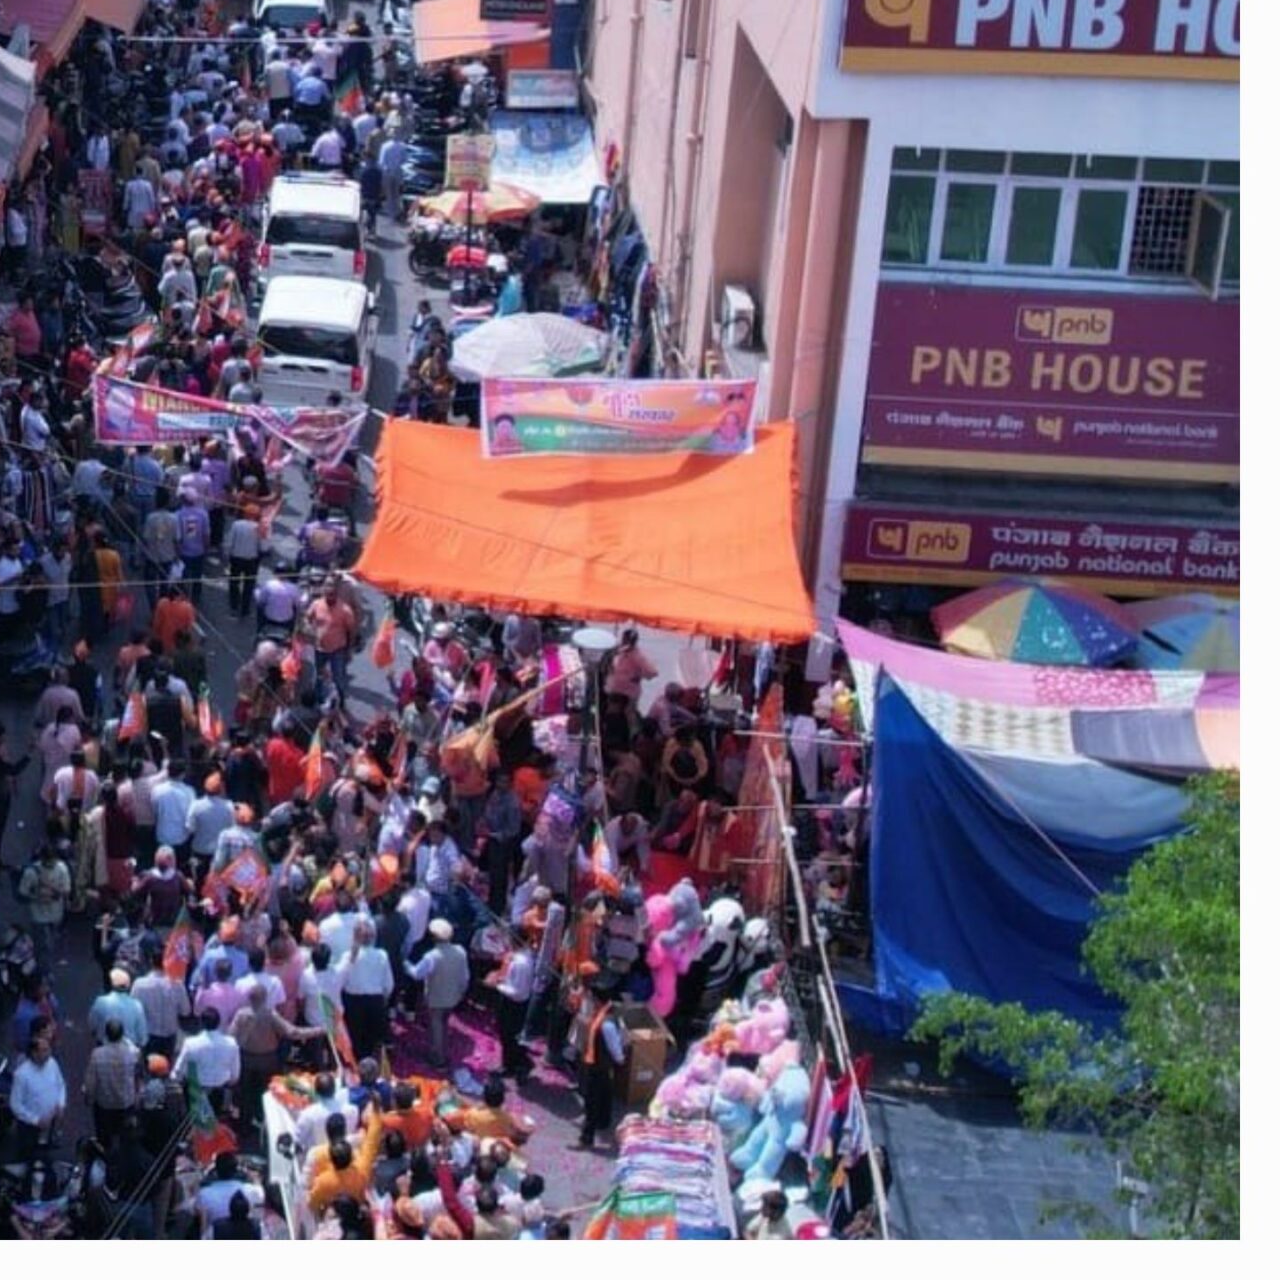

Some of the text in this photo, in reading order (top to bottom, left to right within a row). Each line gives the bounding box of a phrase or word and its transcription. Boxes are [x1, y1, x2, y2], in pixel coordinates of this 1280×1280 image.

[1058, 314, 1107, 337] pnb
[910, 345, 1208, 399] PNB HOUSE
[1184, 423, 1218, 438] bank
[916, 528, 960, 555] pnb
[990, 550, 1240, 580] punjab national bank
